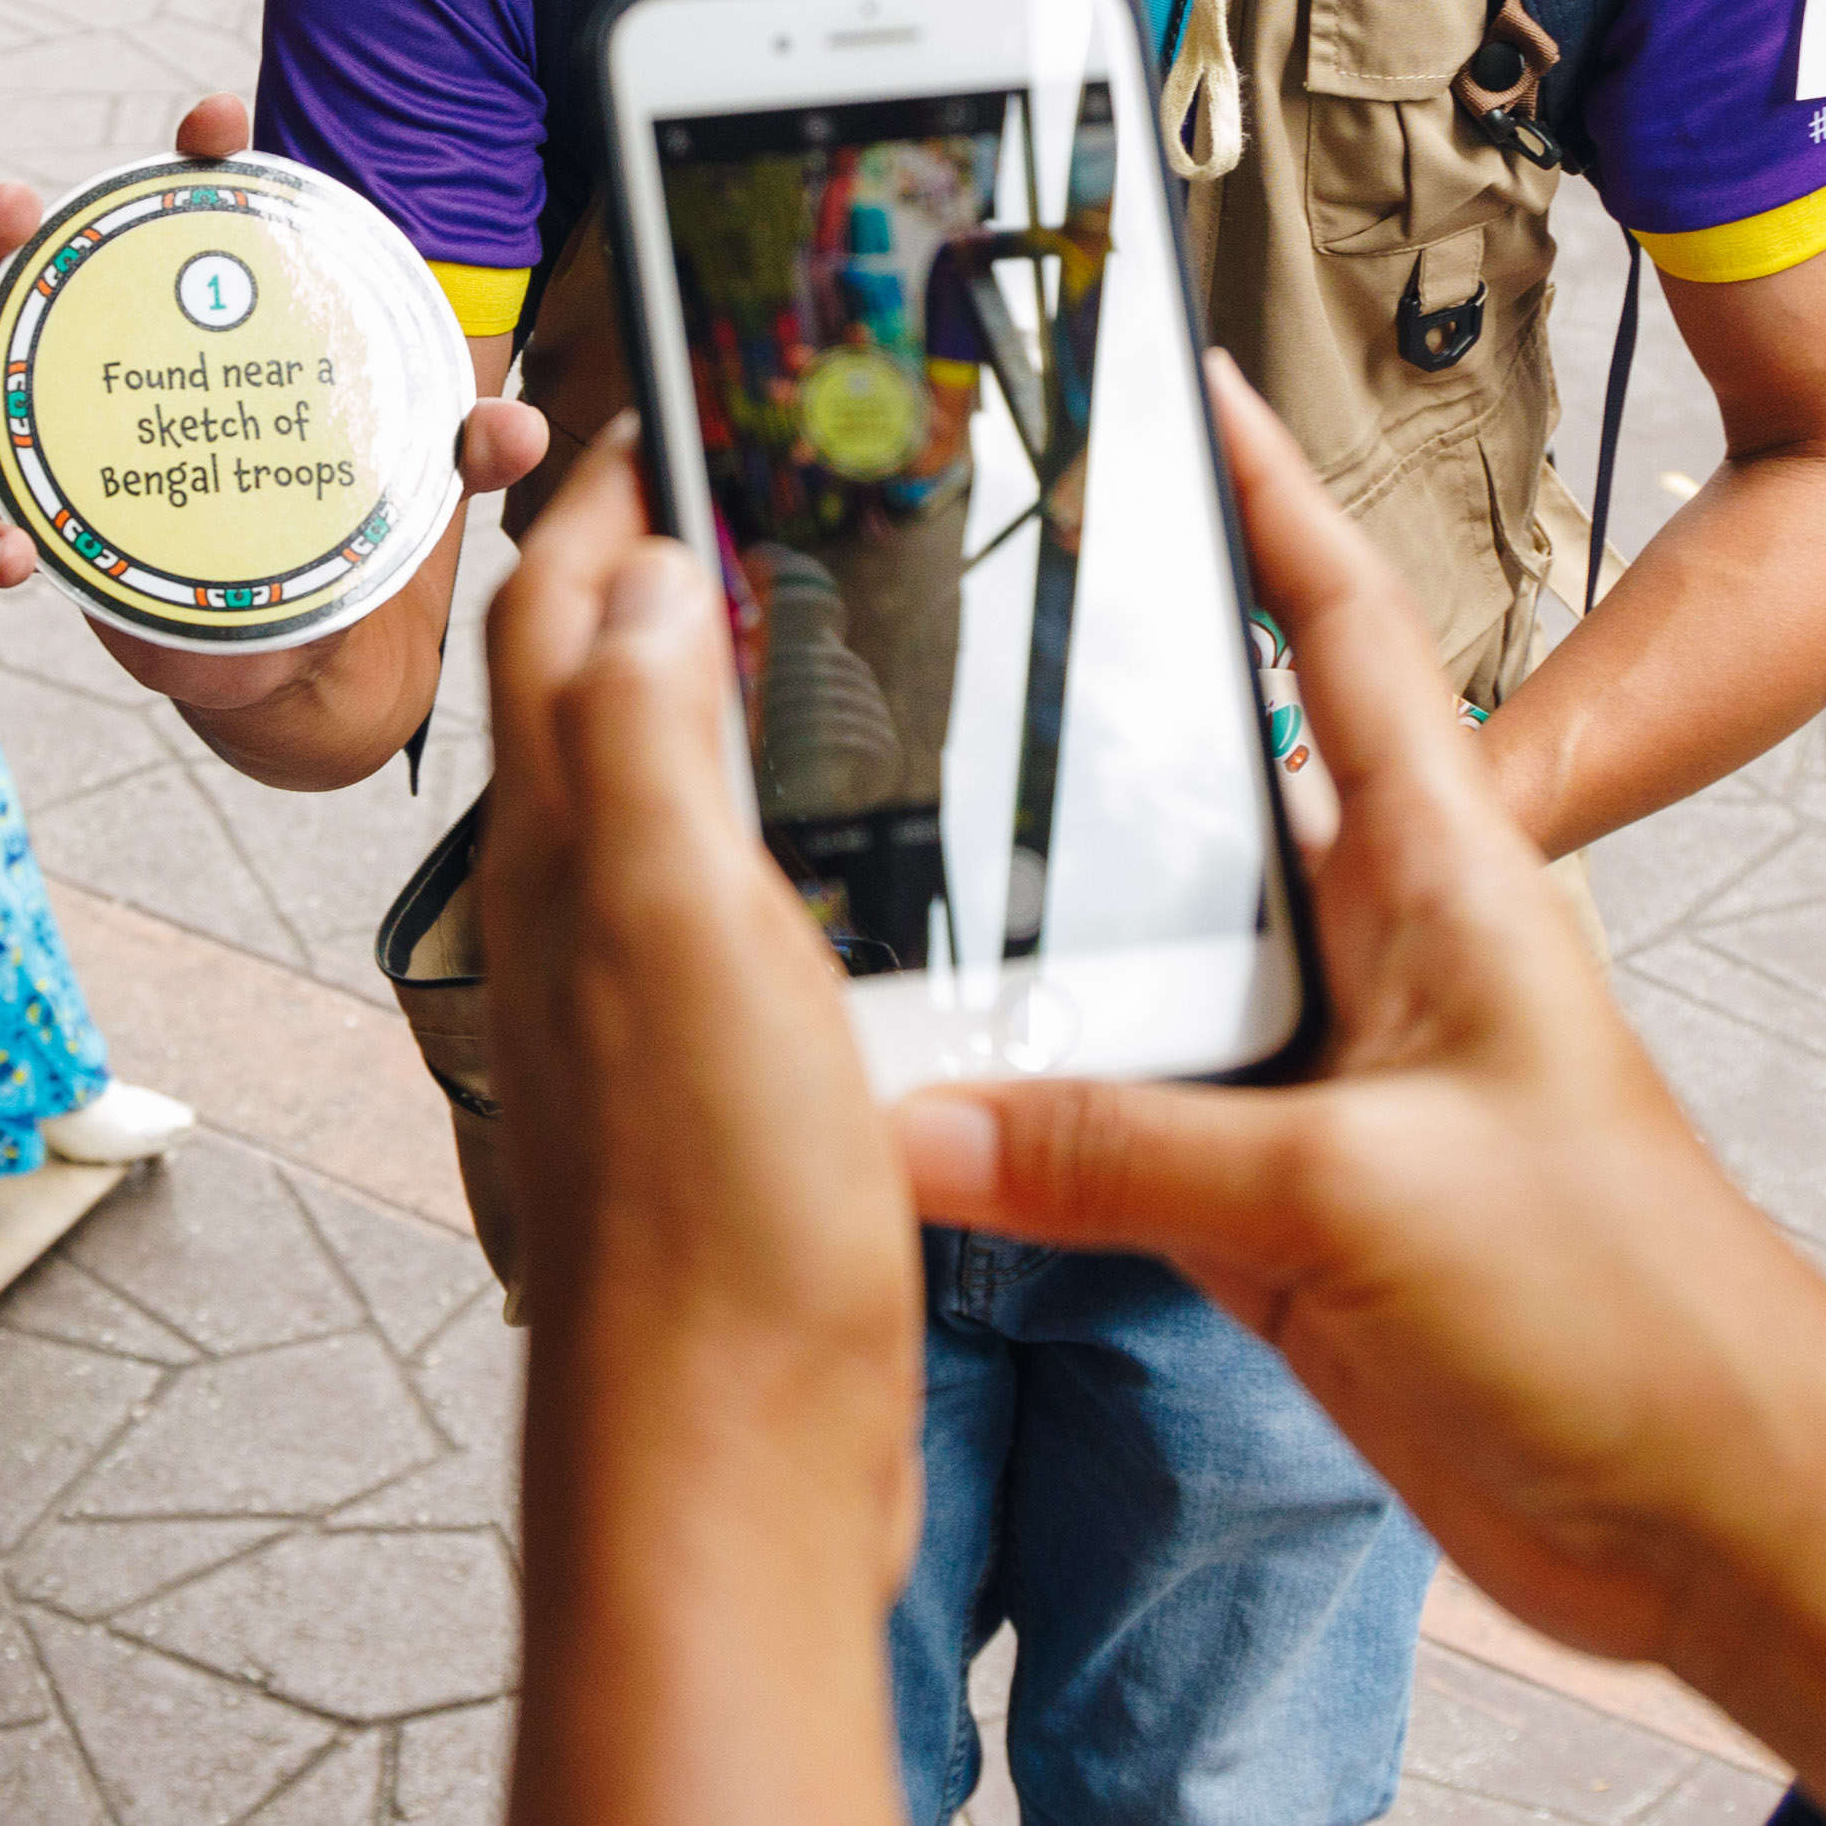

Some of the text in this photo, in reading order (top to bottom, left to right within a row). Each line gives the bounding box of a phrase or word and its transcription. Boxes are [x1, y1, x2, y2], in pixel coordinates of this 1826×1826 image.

[207, 274, 226, 310] 1
[102, 351, 335, 394] Found near a
[138, 400, 310, 448] sketch of
[100, 452, 356, 508] Bengal troops
